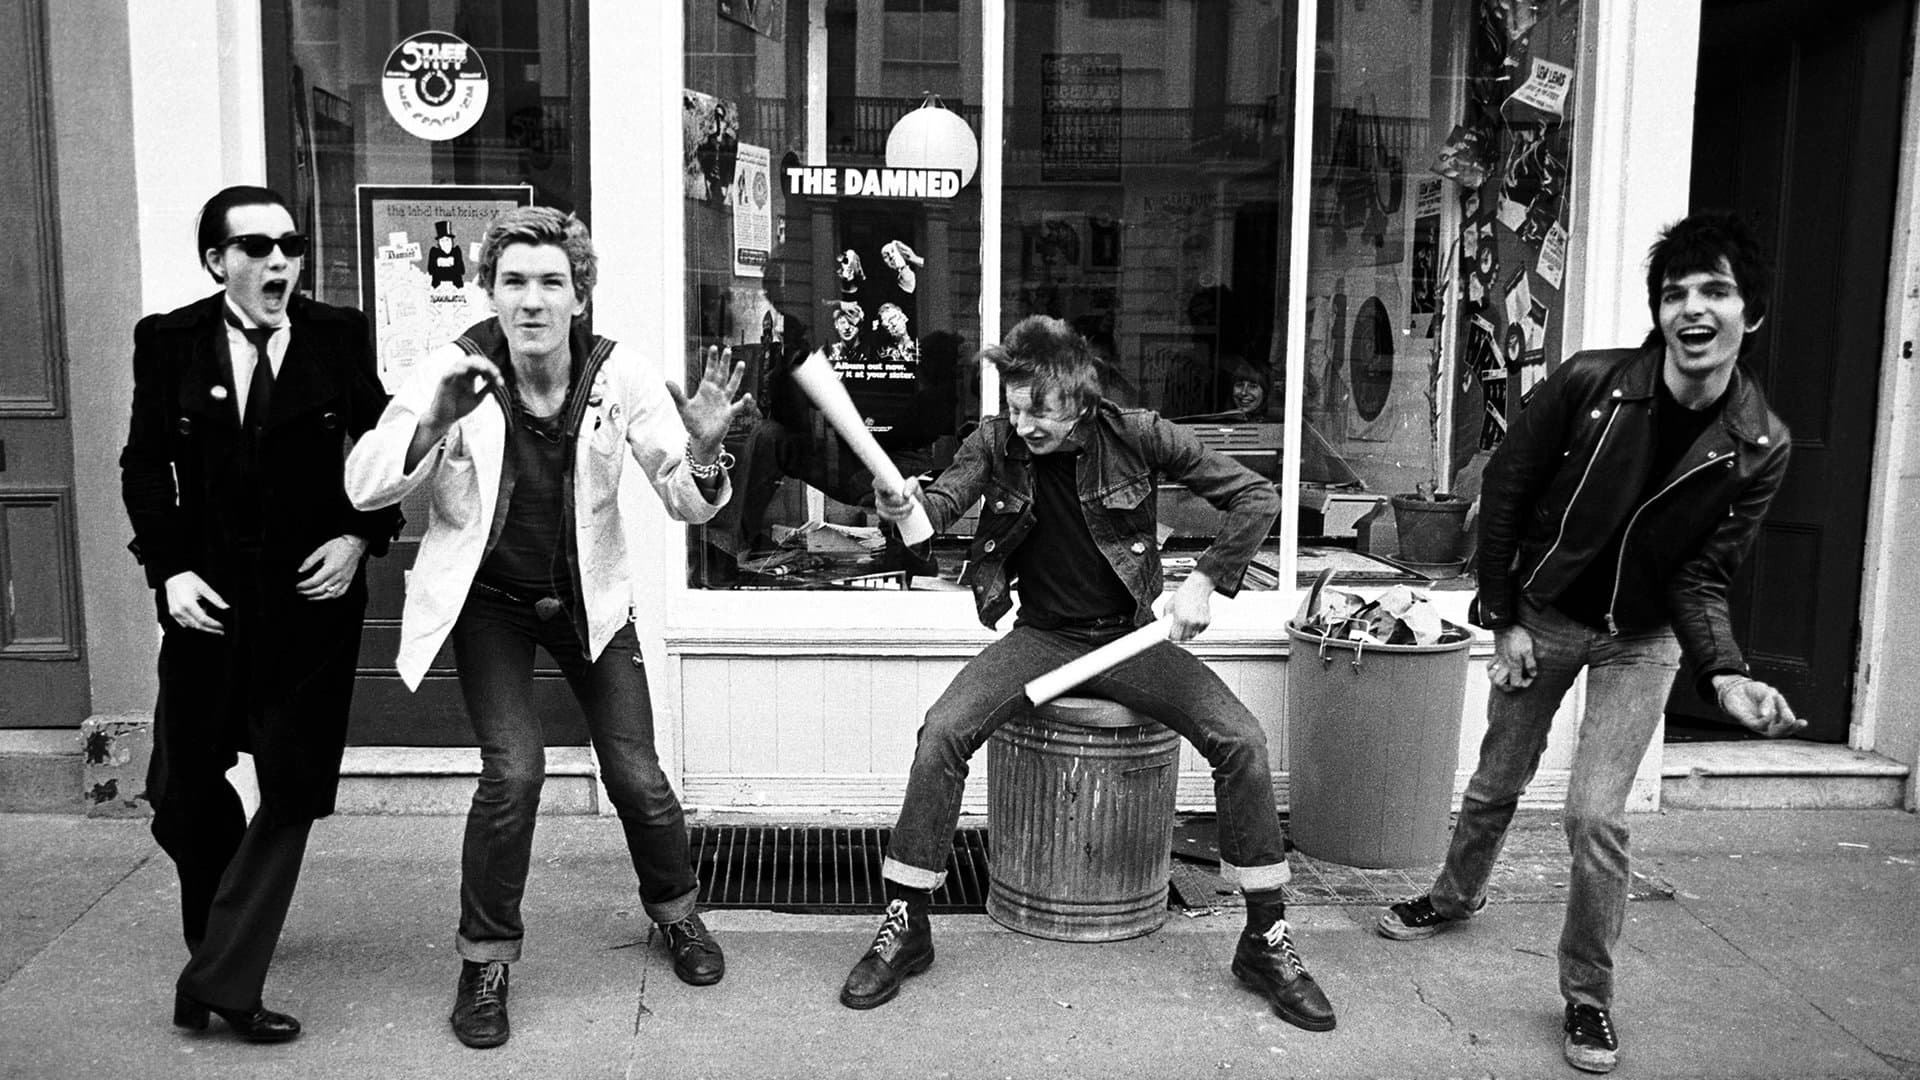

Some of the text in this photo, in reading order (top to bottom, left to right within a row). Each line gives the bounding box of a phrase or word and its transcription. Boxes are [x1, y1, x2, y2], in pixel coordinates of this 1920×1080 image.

[787, 168, 961, 198] THE DAMNED
[387, 204, 405, 217] the
[408, 205, 432, 217] label
[435, 205, 455, 217] that
[457, 205, 488, 220] brings
[834, 362, 865, 370] Album
[866, 372, 887, 380] your
[889, 371, 916, 379] sister.
